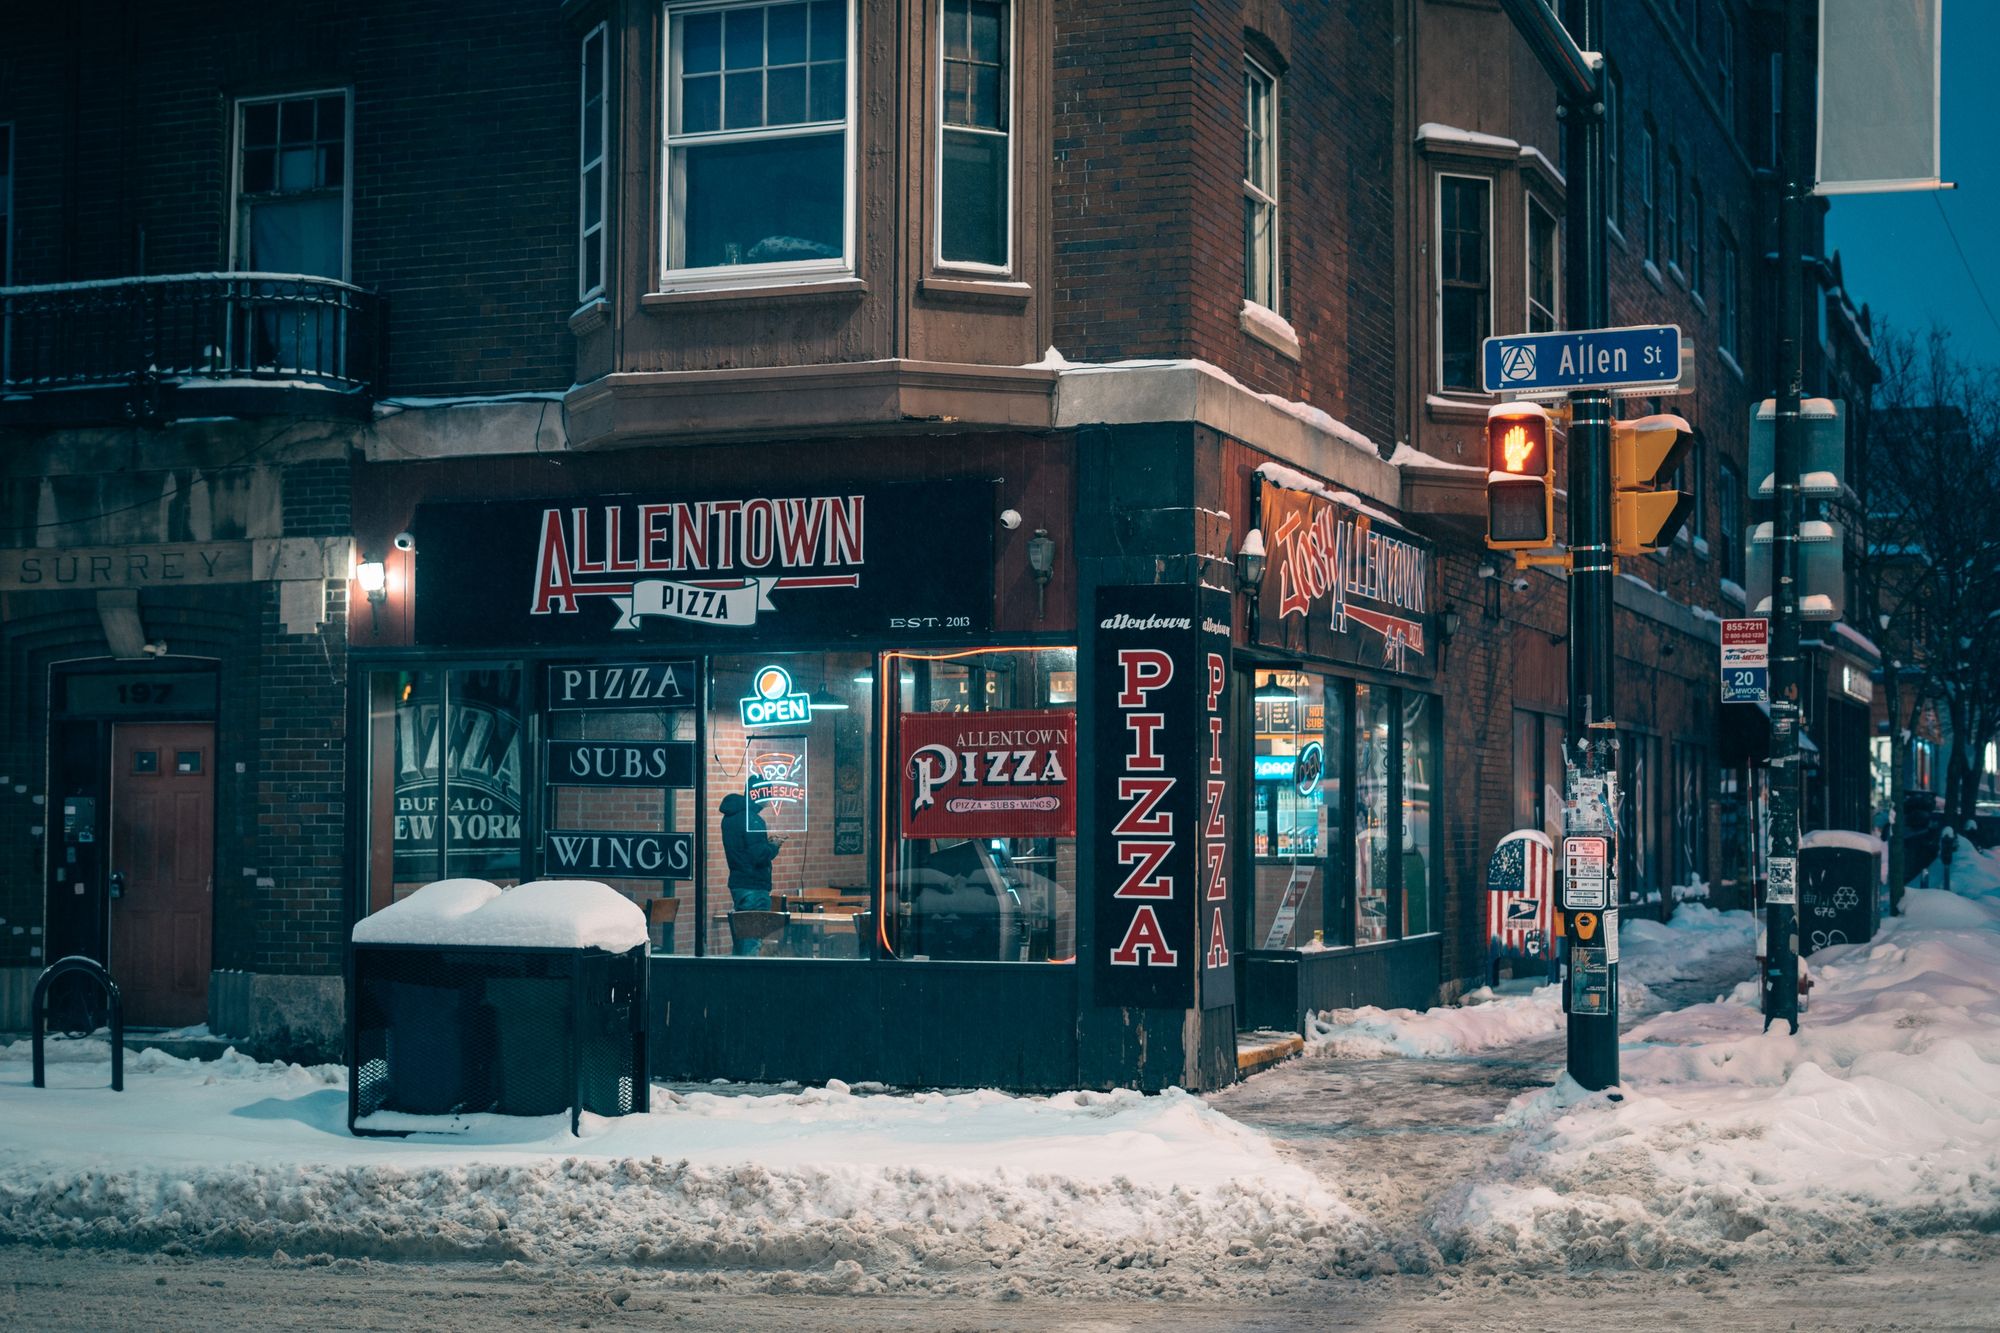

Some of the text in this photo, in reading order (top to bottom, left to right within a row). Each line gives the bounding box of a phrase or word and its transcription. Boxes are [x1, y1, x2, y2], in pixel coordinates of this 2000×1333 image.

[1558, 343, 1627, 376] Allen
[1643, 345, 1662, 365] St
[530, 495, 864, 615] ALLENTOWN
[19, 551, 222, 584] SURREY
[1275, 504, 1426, 633] JOSH ALLENTOWN
[662, 585, 728, 620] PIZZA
[890, 616, 970, 629] EST. 2013
[1100, 613, 1192, 631] allentown
[1202, 617, 1231, 638] allentown
[1726, 622, 1763, 631] 855-7211
[562, 665, 685, 701] PIZZA
[1734, 671, 1754, 686] 20
[116, 682, 173, 705] 197
[1729, 687, 1763, 695] LMWOOD
[747, 699, 805, 723] OPEN
[396, 703, 520, 797] IZZA
[956, 729, 1068, 747] ALLENTOWN
[569, 747, 667, 778] SUBS
[906, 743, 1068, 811] PIZZA
[398, 797, 493, 811] BUFALO
[750, 786, 805, 800] BY THE SLICE
[955, 800, 1052, 809] PIZZA SUBS WINGS
[1110, 649, 1178, 967] PIZZA
[1205, 652, 1229, 969] PIZZA
[394, 815, 438, 840] EW
[550, 836, 688, 870] WINGS
[1814, 907, 1836, 918] 678
